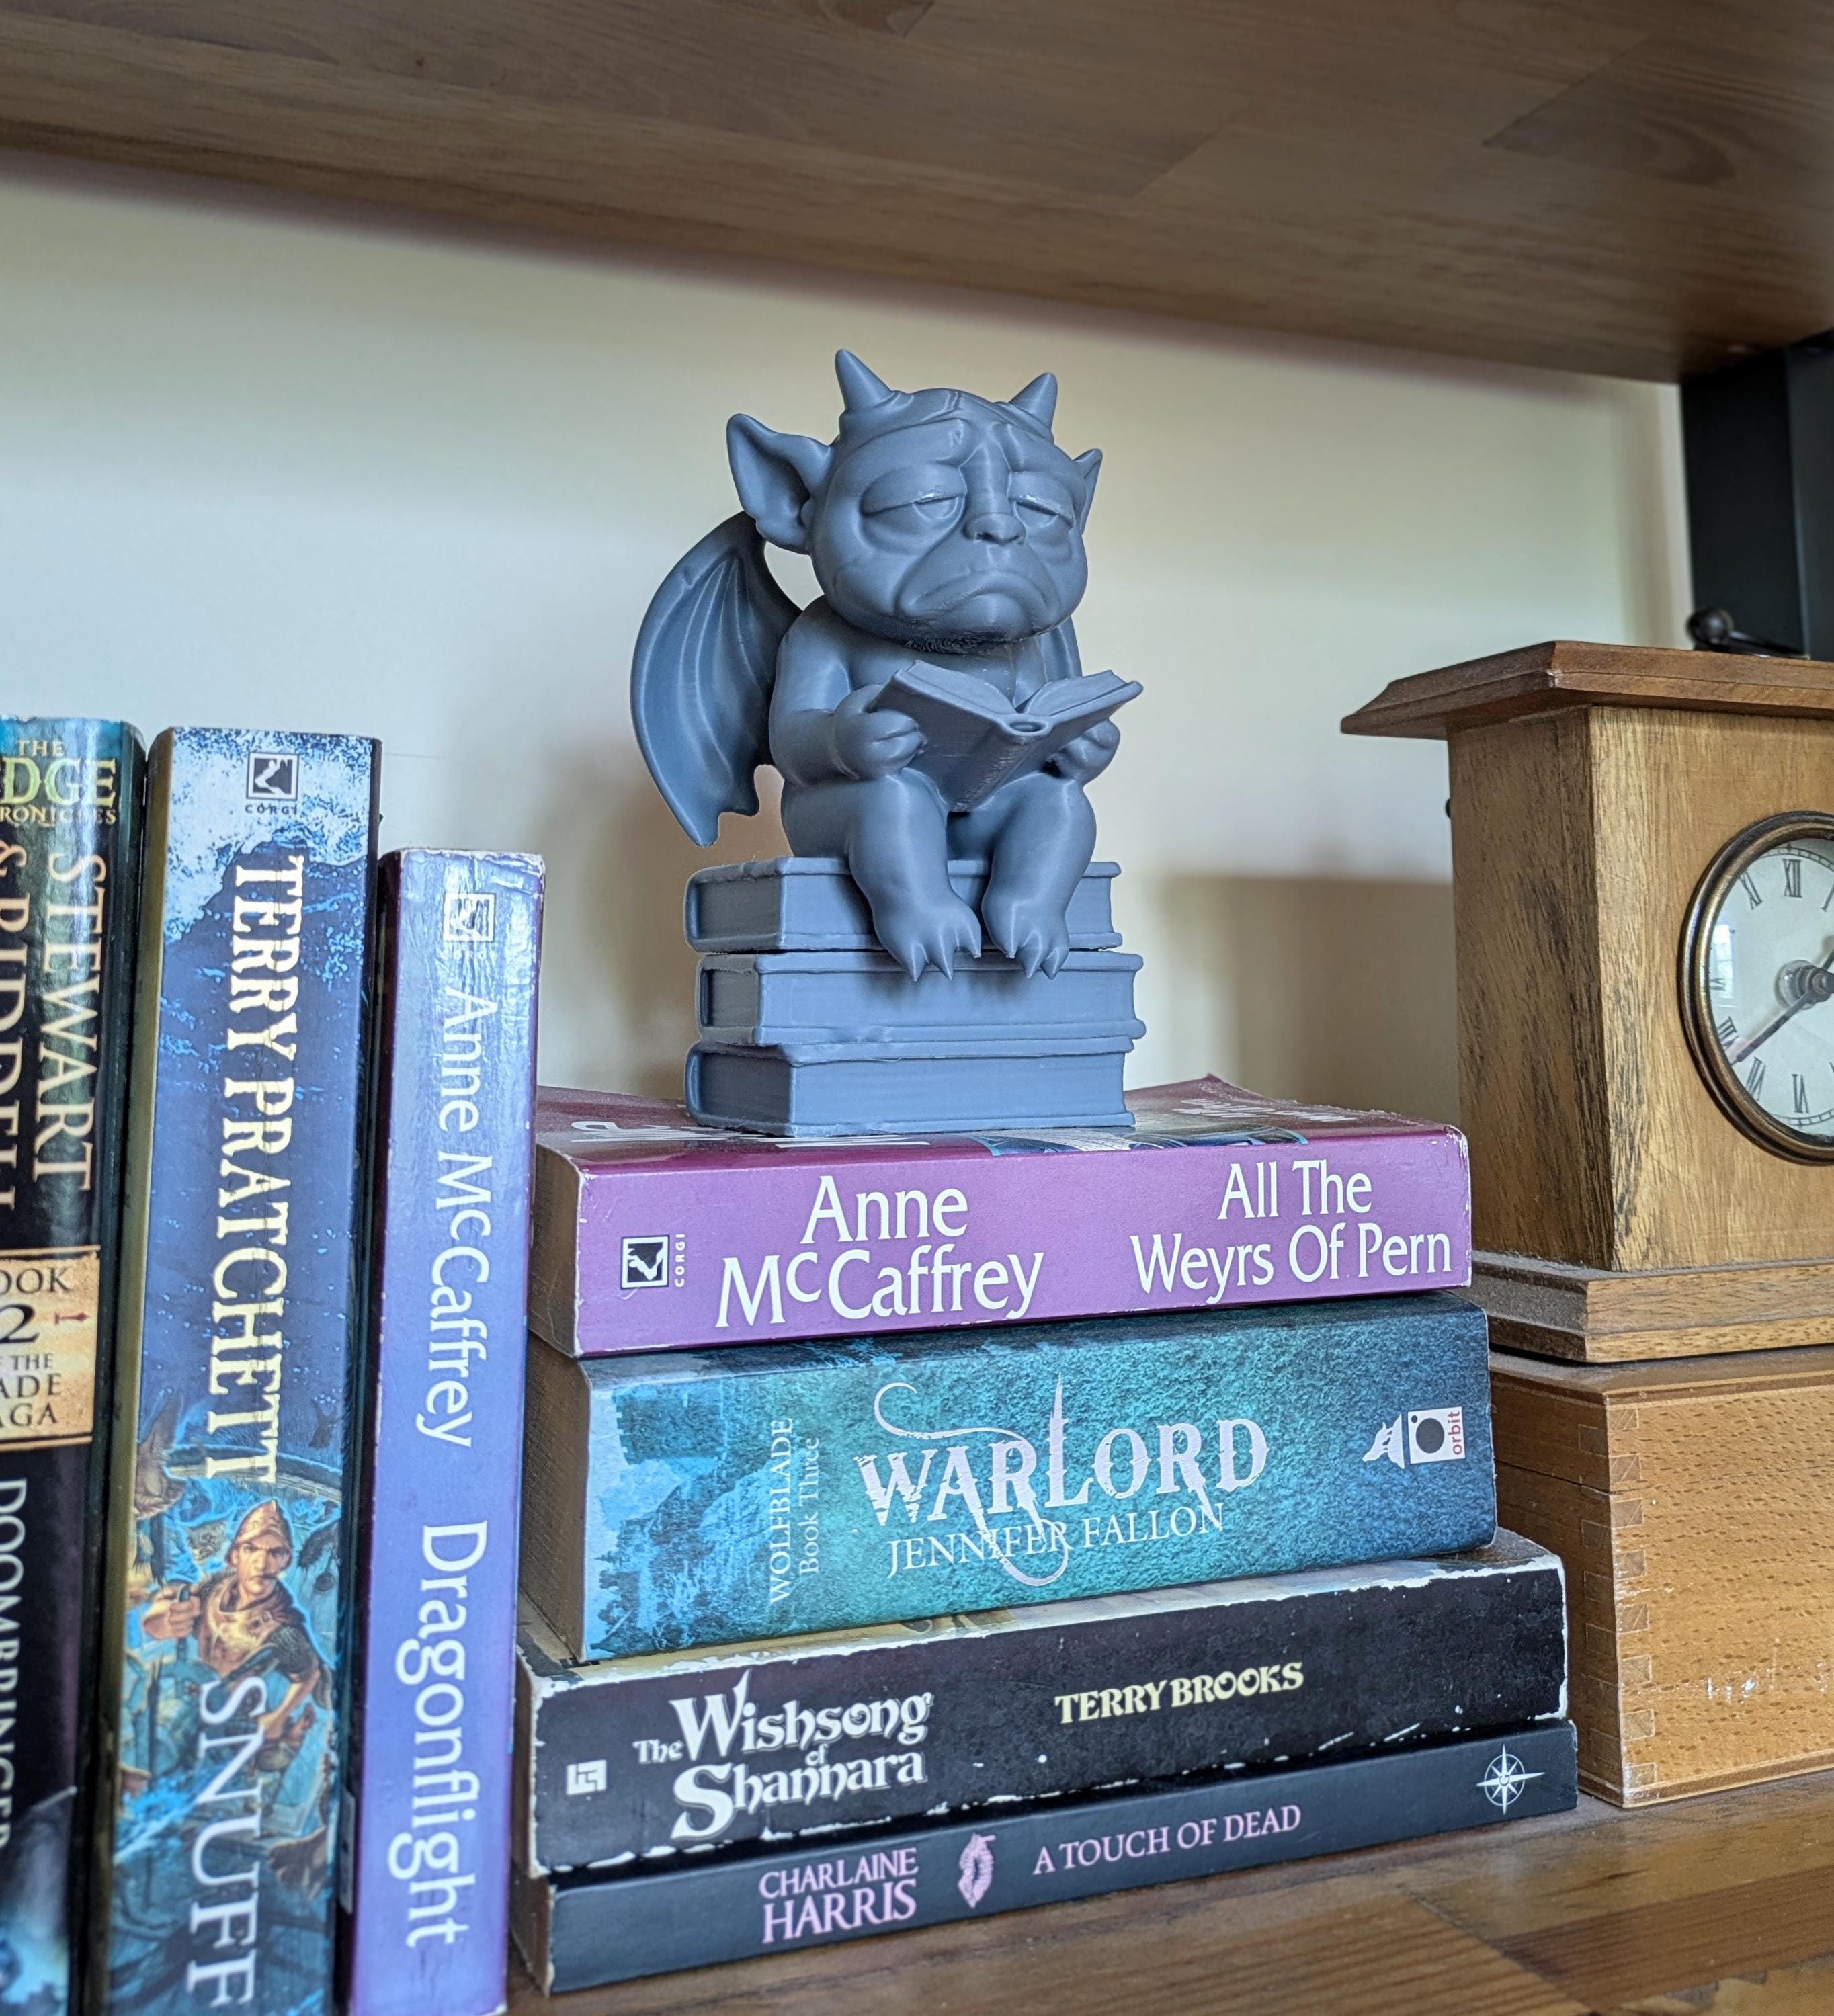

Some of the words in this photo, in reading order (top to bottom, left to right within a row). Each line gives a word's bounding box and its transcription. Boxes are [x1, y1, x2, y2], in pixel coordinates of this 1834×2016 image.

[0, 757, 116, 808] DGE
[17, 739, 65, 757] THE
[245, 804, 298, 815] CORGI
[226, 853, 305, 1062] TERRY
[32, 852, 107, 1191] STEWART
[437, 986, 499, 1133] Anne
[800, 1175, 968, 1245] Anne
[1218, 1161, 1279, 1220] All
[1292, 1159, 1373, 1214] The
[204, 1077, 297, 1485] PRATCHETT
[675, 1234, 685, 1288] CORGI
[715, 1243, 1044, 1329] McCaffrey
[1130, 1233, 1274, 1305] Weyrs
[1288, 1222, 1346, 1283] Of
[1358, 1222, 1452, 1279] Pern
[415, 1151, 493, 1449] McCaffrey
[12, 1353, 54, 1371] THE
[1448, 1409, 1462, 1456] orbit
[798, 1436, 821, 1508] Three
[853, 1372, 1272, 1586] WARLORD
[769, 1417, 794, 1605] WOLFBLADE
[798, 1511, 820, 1576] Book
[887, 1519, 1074, 1579] JENNIFER
[1083, 1501, 1224, 1549] FALLON
[632, 1738, 683, 1765] The
[669, 1668, 935, 1761] Wishsong
[1054, 1679, 1166, 1725] TERRY
[1171, 1661, 1305, 1705] BROOKS
[387, 1519, 489, 1946] Dragonflight
[806, 1743, 832, 1767] of
[671, 1751, 929, 1841] Shannara
[185, 1674, 268, 2009] SNUFF
[758, 1847, 919, 1900] CHARLAINE
[1032, 1850, 1055, 1876] A
[1064, 1828, 1171, 1868] TOUCH
[1177, 1818, 1217, 1847] OF
[1222, 1804, 1302, 1843] DEAD
[761, 1878, 918, 1945] HARRIS
